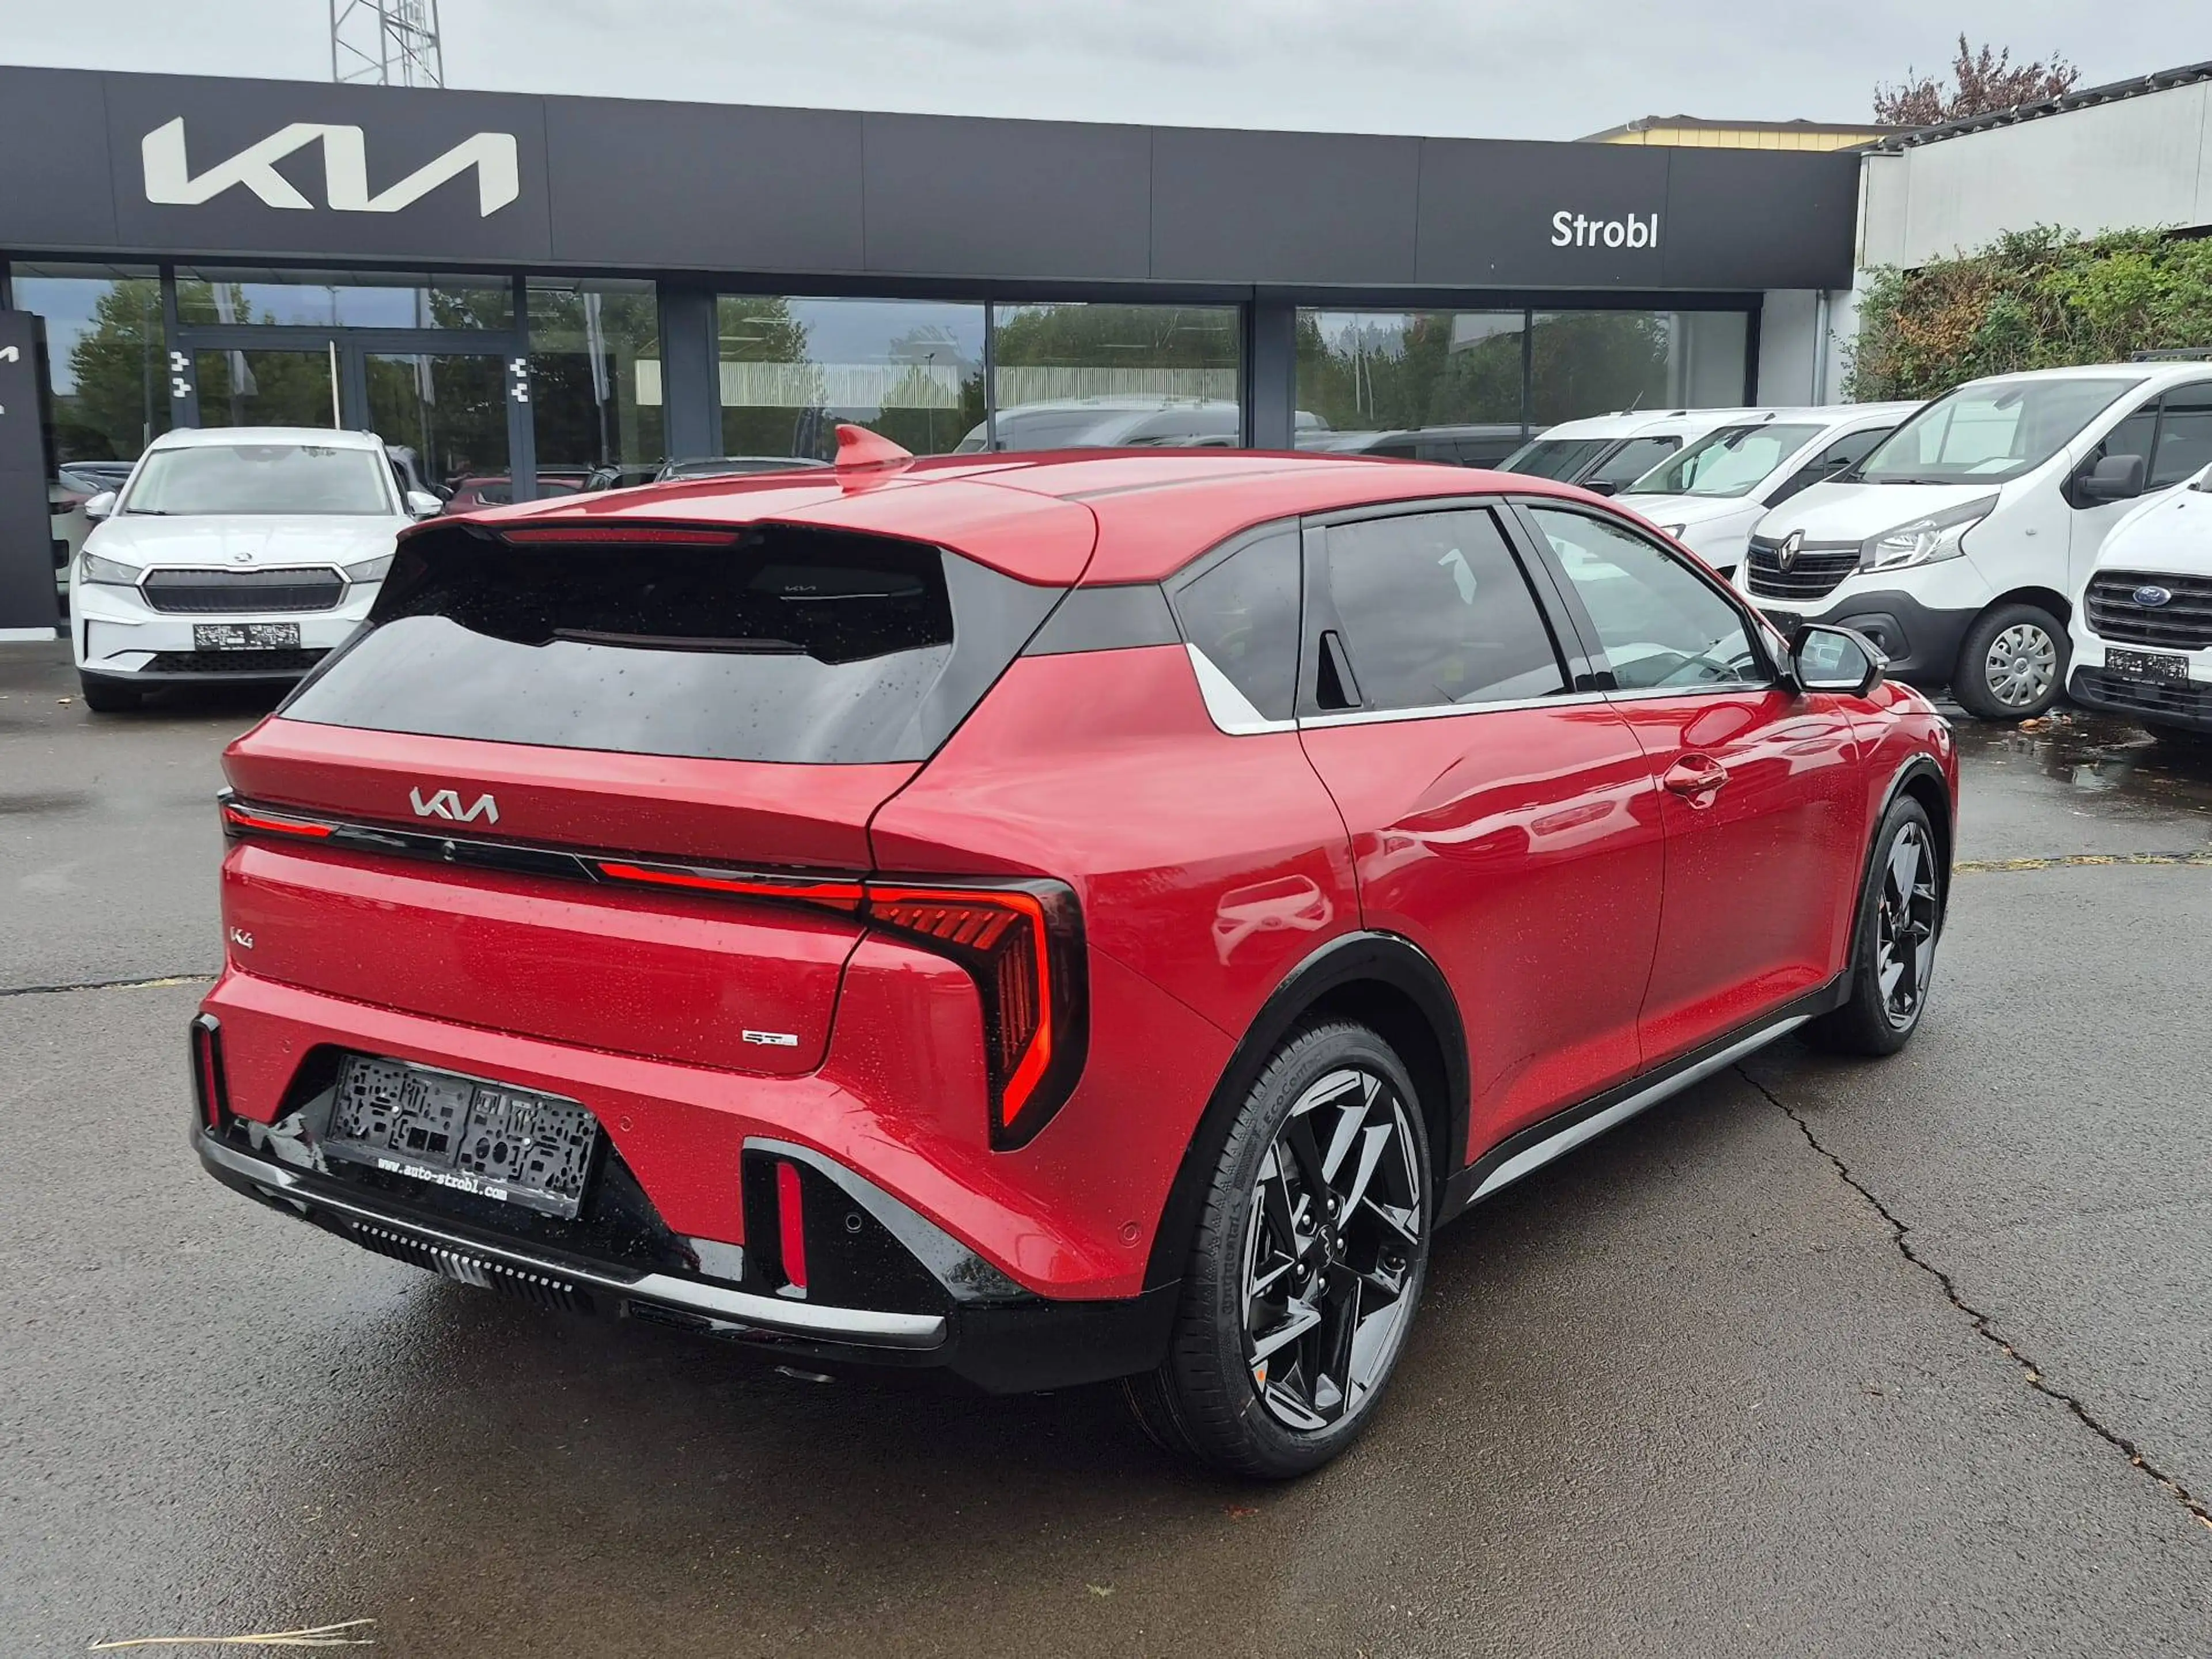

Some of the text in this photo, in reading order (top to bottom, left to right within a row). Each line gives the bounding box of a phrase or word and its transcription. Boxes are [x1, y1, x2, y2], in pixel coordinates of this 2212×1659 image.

[142, 115, 519, 218] KIA
[1551, 211, 1658, 248] Strobl
[409, 786, 499, 824] KIA
[230, 926, 253, 949] K4
[378, 1158, 507, 1201] www.auto-strobl.com
